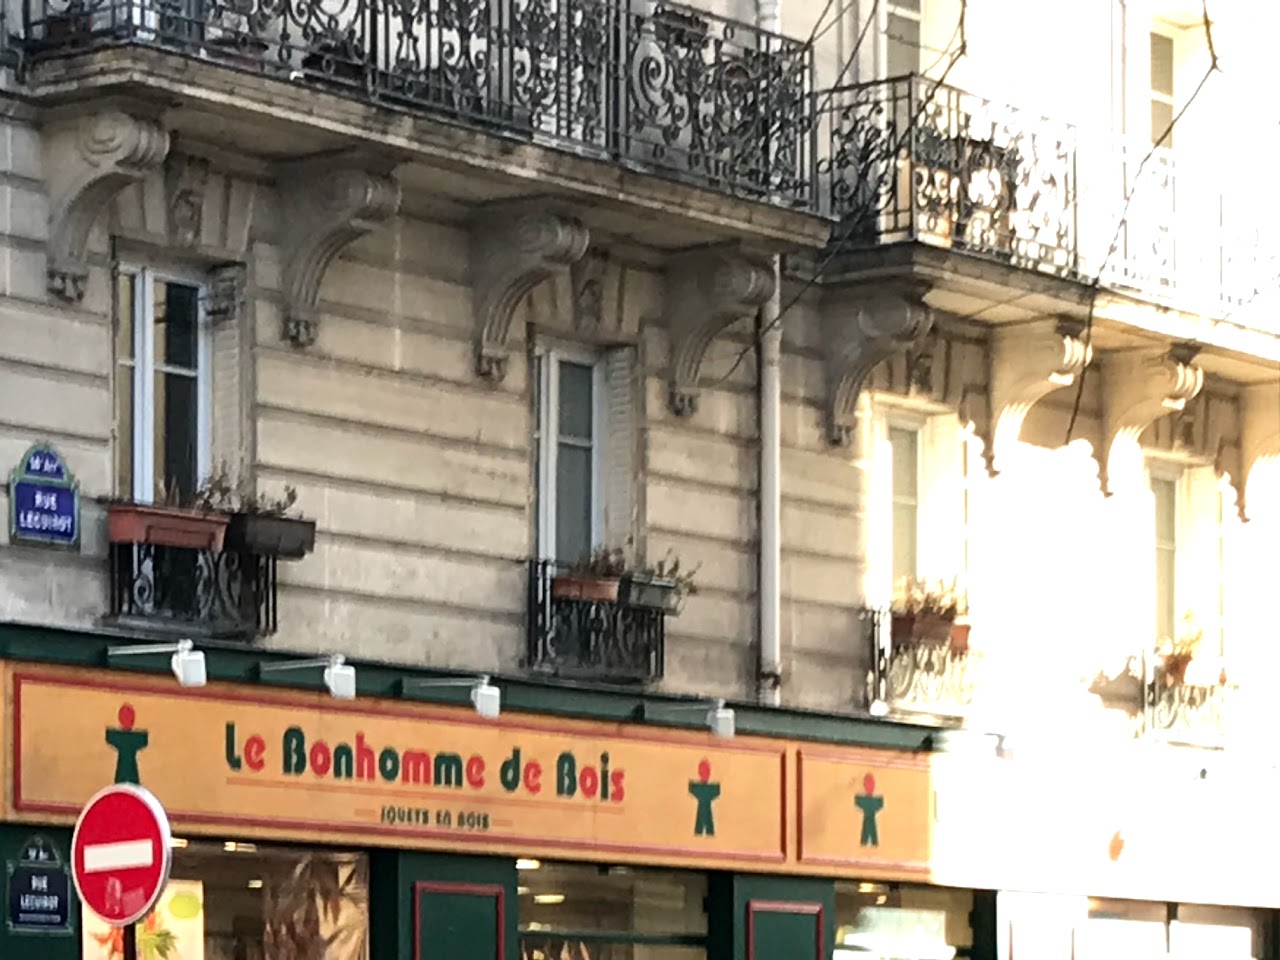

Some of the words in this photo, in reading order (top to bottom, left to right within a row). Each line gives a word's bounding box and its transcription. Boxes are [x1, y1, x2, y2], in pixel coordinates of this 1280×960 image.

[34, 490, 57, 510] RUE
[225, 721, 266, 771] Le
[282, 725, 486, 790] Bonhomme
[499, 746, 542, 794] de
[556, 751, 625, 803] Bois
[381, 805, 429, 825] JOUETS
[457, 810, 490, 830] BOIS
